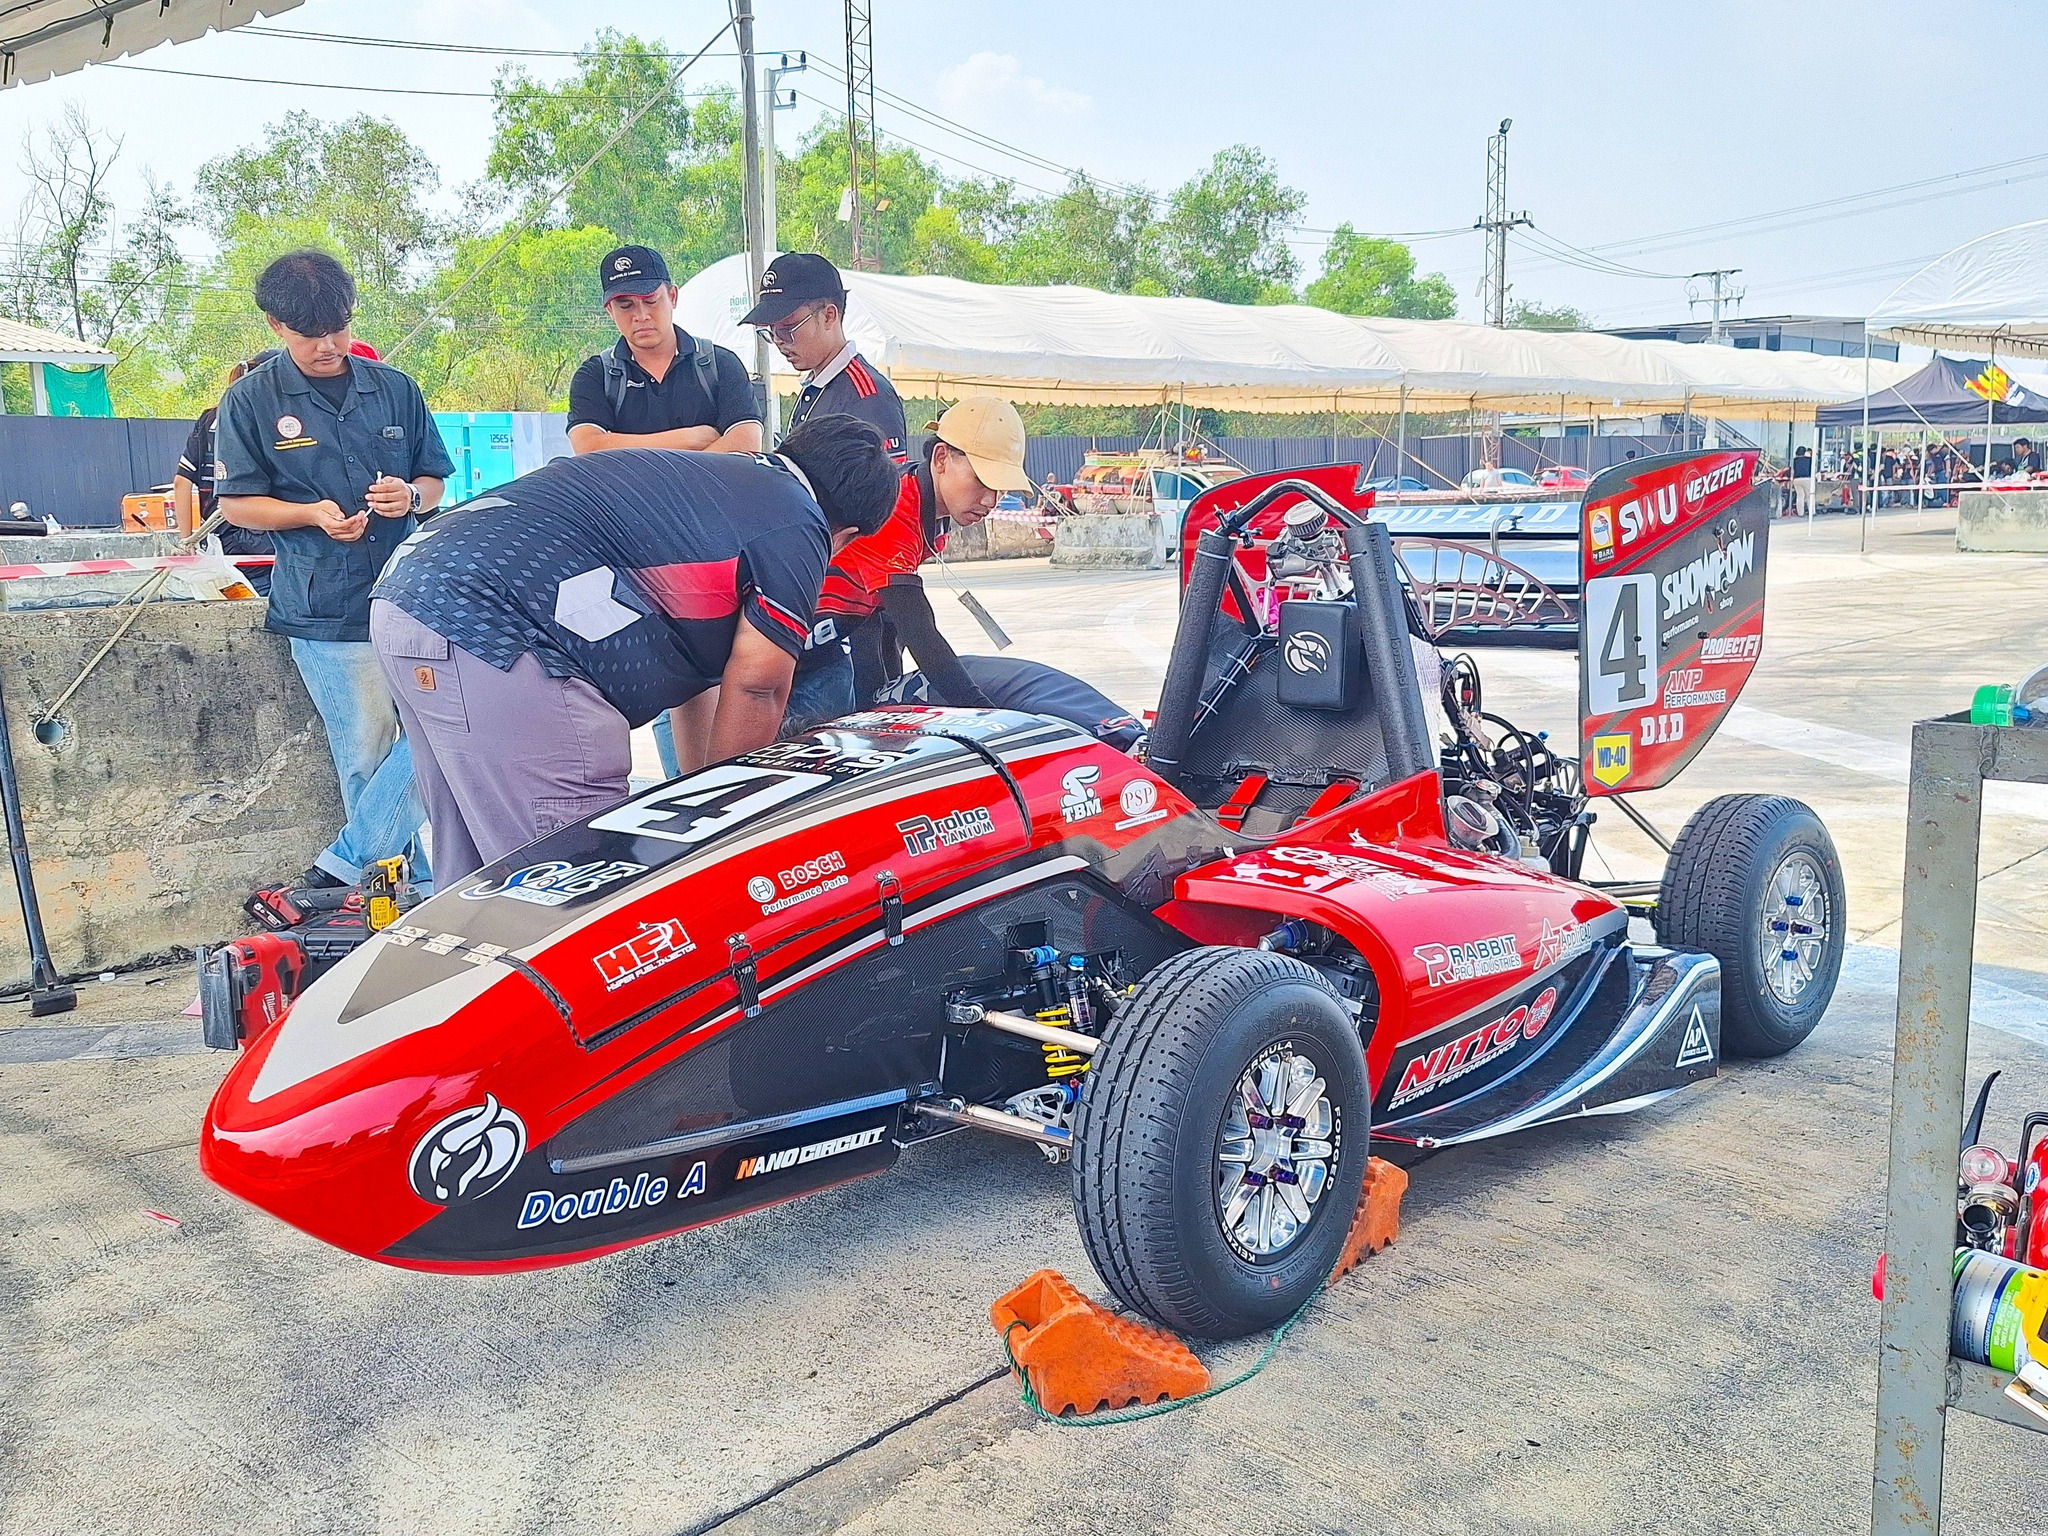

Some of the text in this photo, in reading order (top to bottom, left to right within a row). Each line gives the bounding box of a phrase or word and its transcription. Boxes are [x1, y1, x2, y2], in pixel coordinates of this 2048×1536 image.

[1618, 458, 1745, 545] SWU NEXZTER
[1600, 582, 1647, 702] 4
[1662, 615, 1699, 642] performance
[1665, 668, 1703, 693] ANP
[736, 756, 864, 775] COMBINATION
[1597, 745, 1626, 769] WD-40
[637, 772, 796, 835] 4
[1062, 798, 1103, 824] TBM
[1125, 787, 1152, 809] PSP
[778, 851, 846, 890] BOSCH
[762, 875, 849, 915] Performance Parts
[1448, 935, 1515, 965] RABBIT
[1454, 955, 1521, 980] PRO INDUSTRIES
[1393, 1005, 1528, 1097] NITTO
[1687, 1027, 1702, 1049] AP
[1235, 1040, 1293, 1092] FORMULA
[1387, 1039, 1518, 1112] RACING PERFORMANCE
[1326, 1105, 1343, 1191] FORGED
[517, 1160, 708, 1230] Double A
